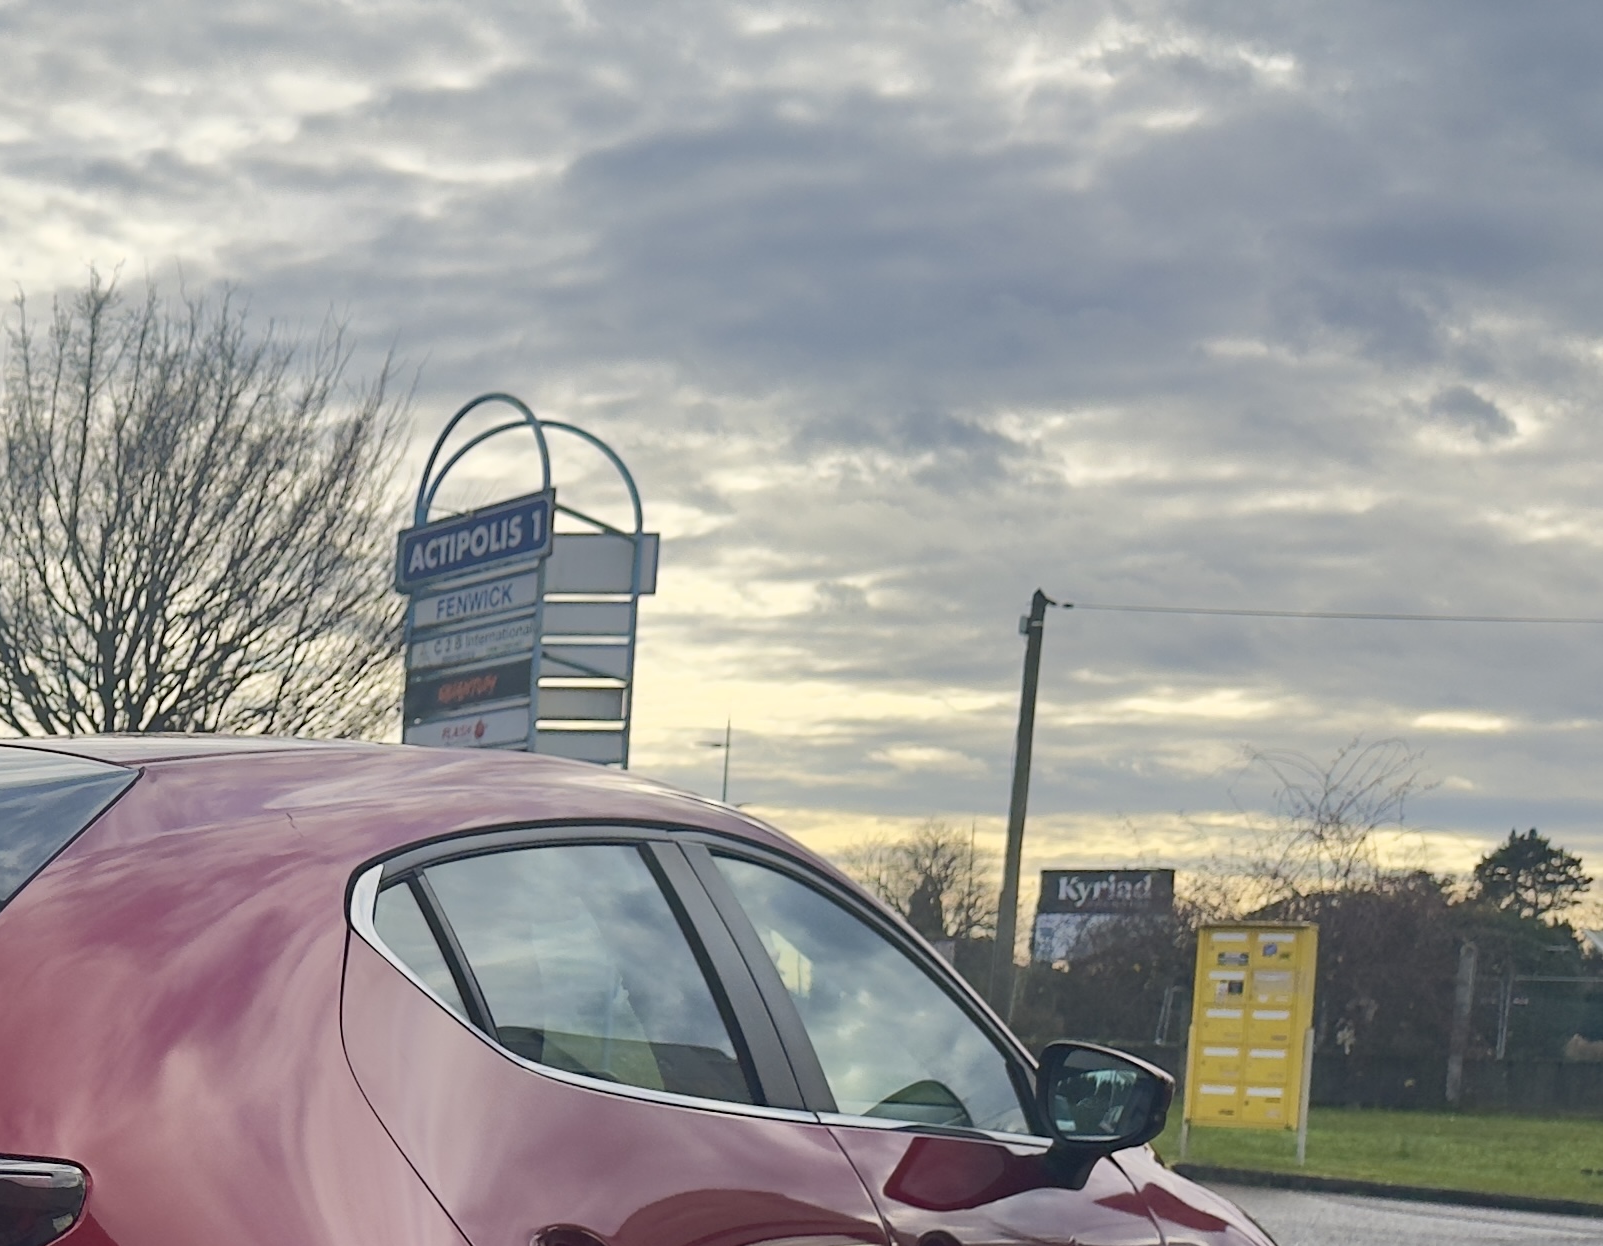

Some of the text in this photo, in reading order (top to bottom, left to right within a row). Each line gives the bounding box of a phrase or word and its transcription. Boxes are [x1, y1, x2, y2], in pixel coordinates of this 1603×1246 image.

[408, 509, 542, 574] ACTIPOLIS 1
[437, 583, 513, 620] FENWICK
[1058, 874, 1152, 908] Kyriad
